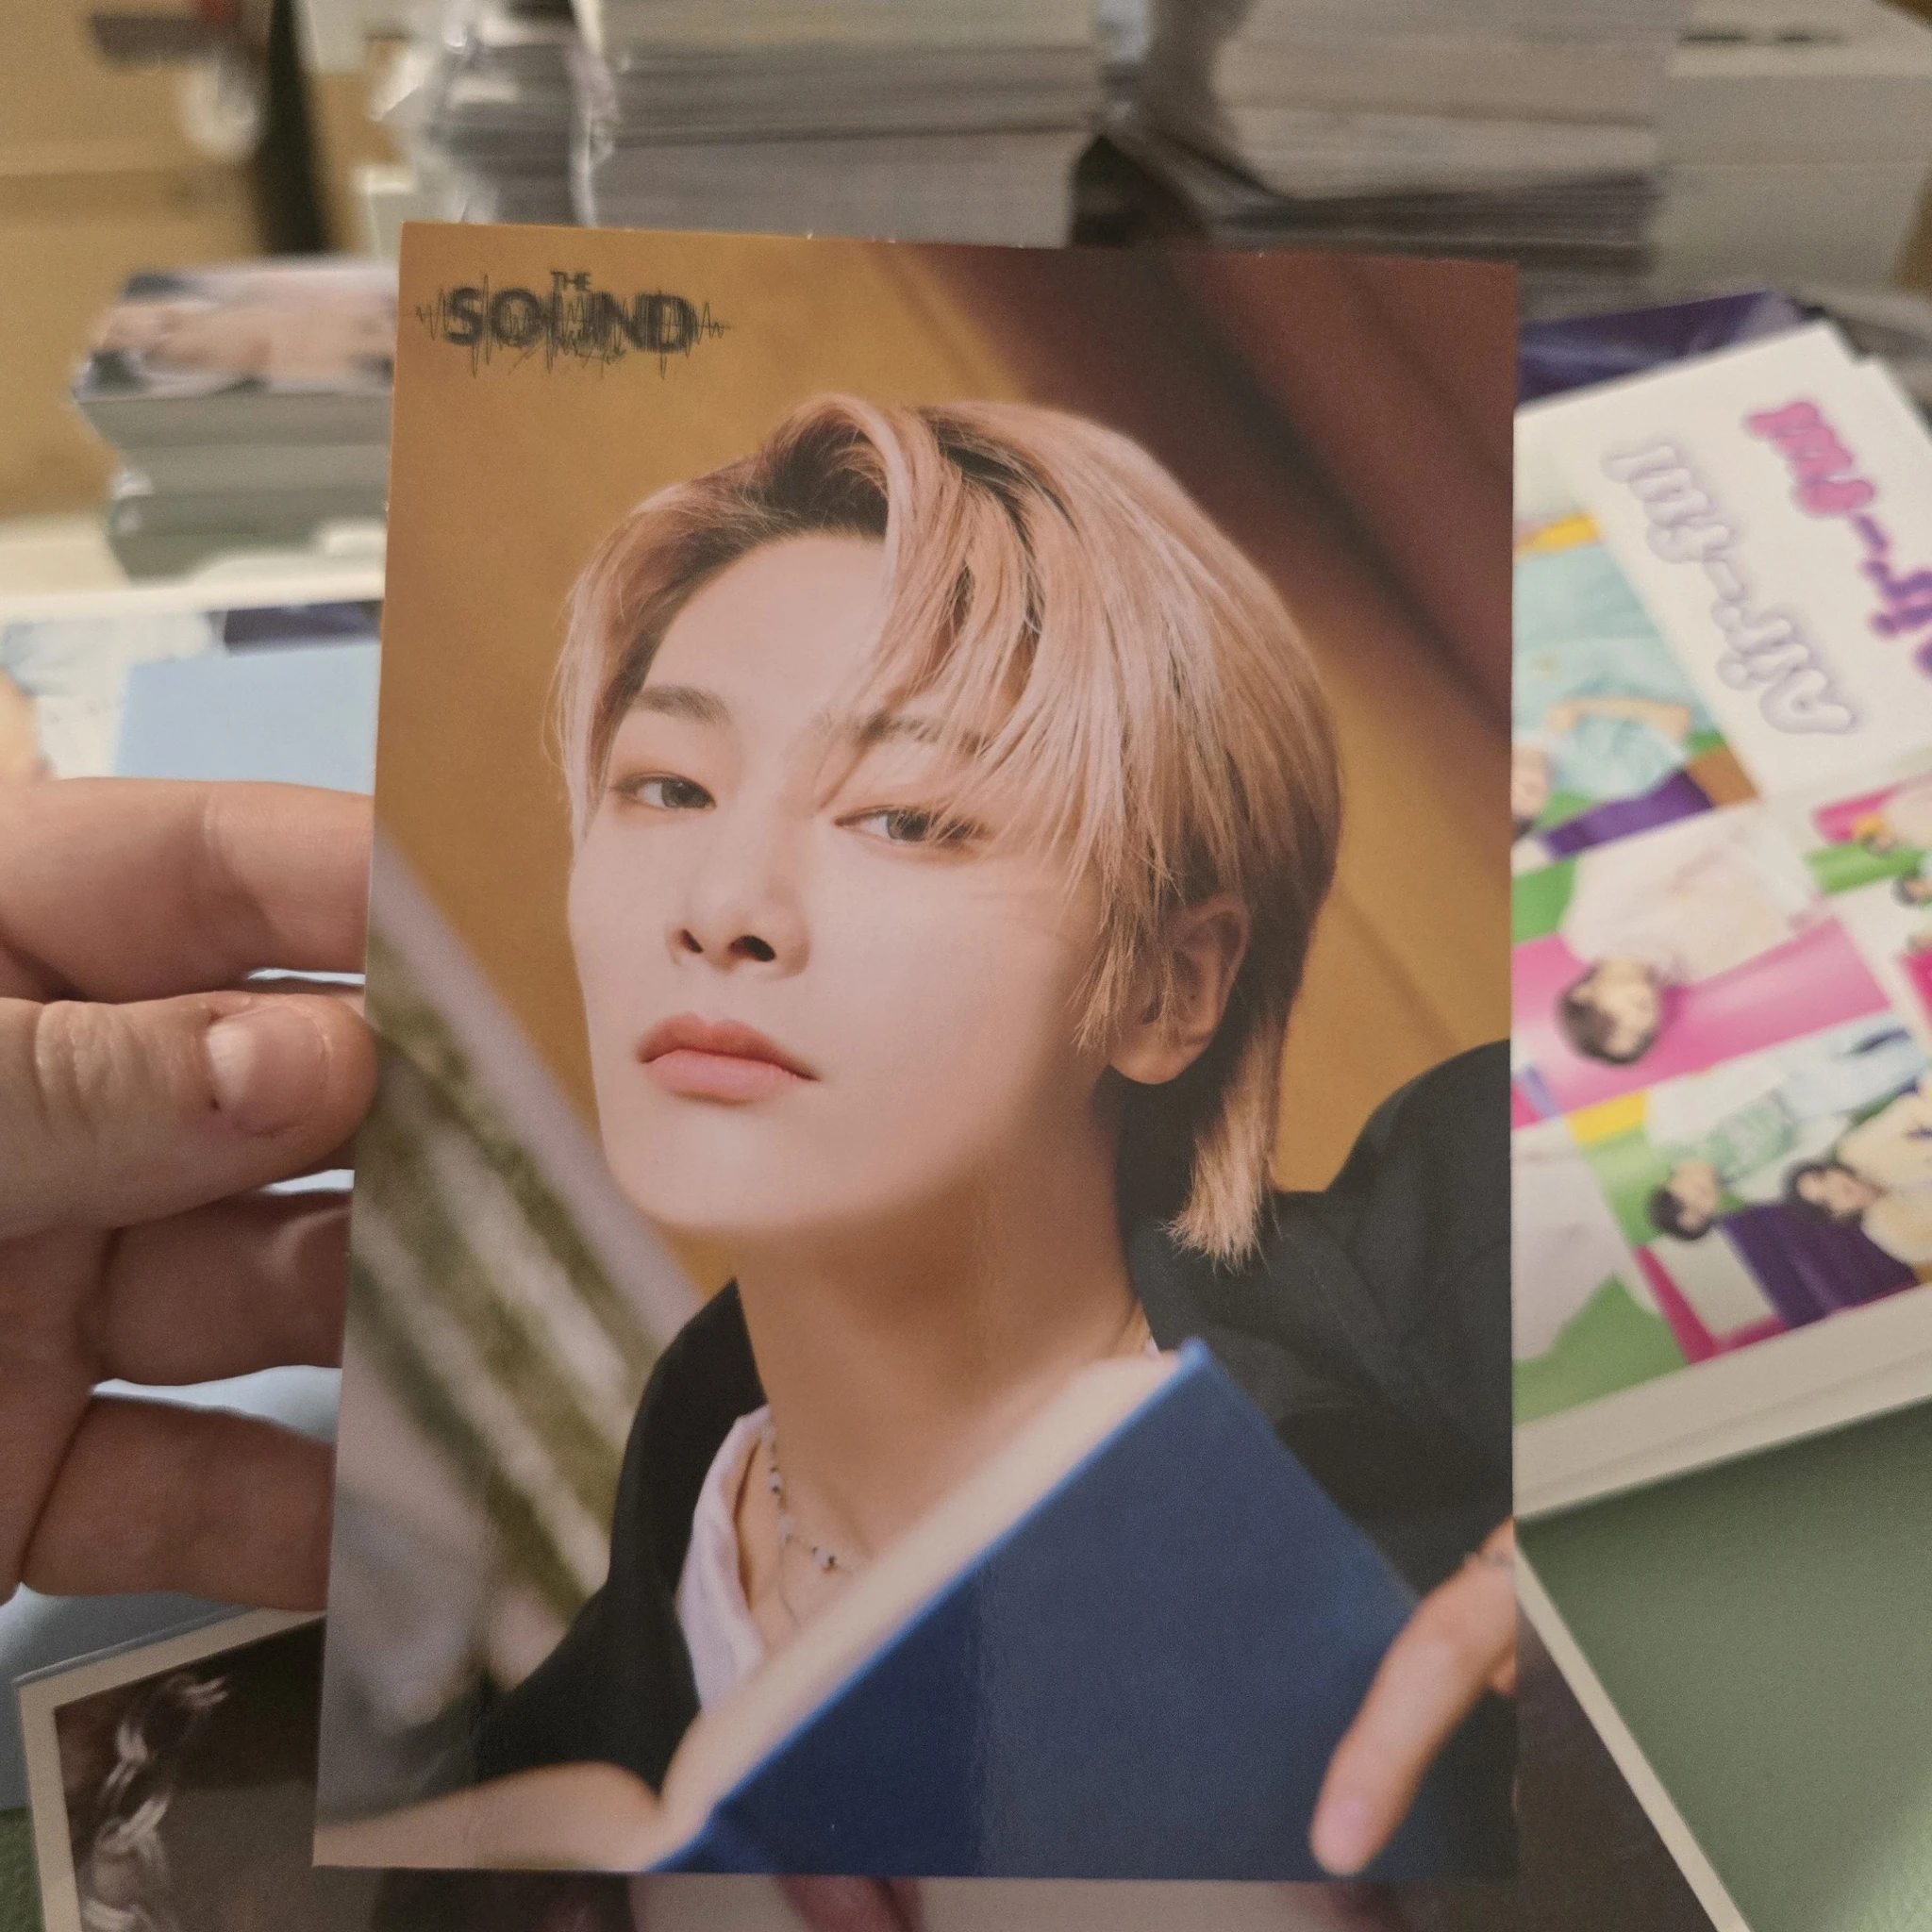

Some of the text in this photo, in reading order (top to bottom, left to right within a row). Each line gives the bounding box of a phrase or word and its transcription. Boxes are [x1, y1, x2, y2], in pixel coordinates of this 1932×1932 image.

[550, 270, 592, 292] THE
[440, 282, 704, 359] SOUND
[1745, 401, 1932, 681] ir-ful
